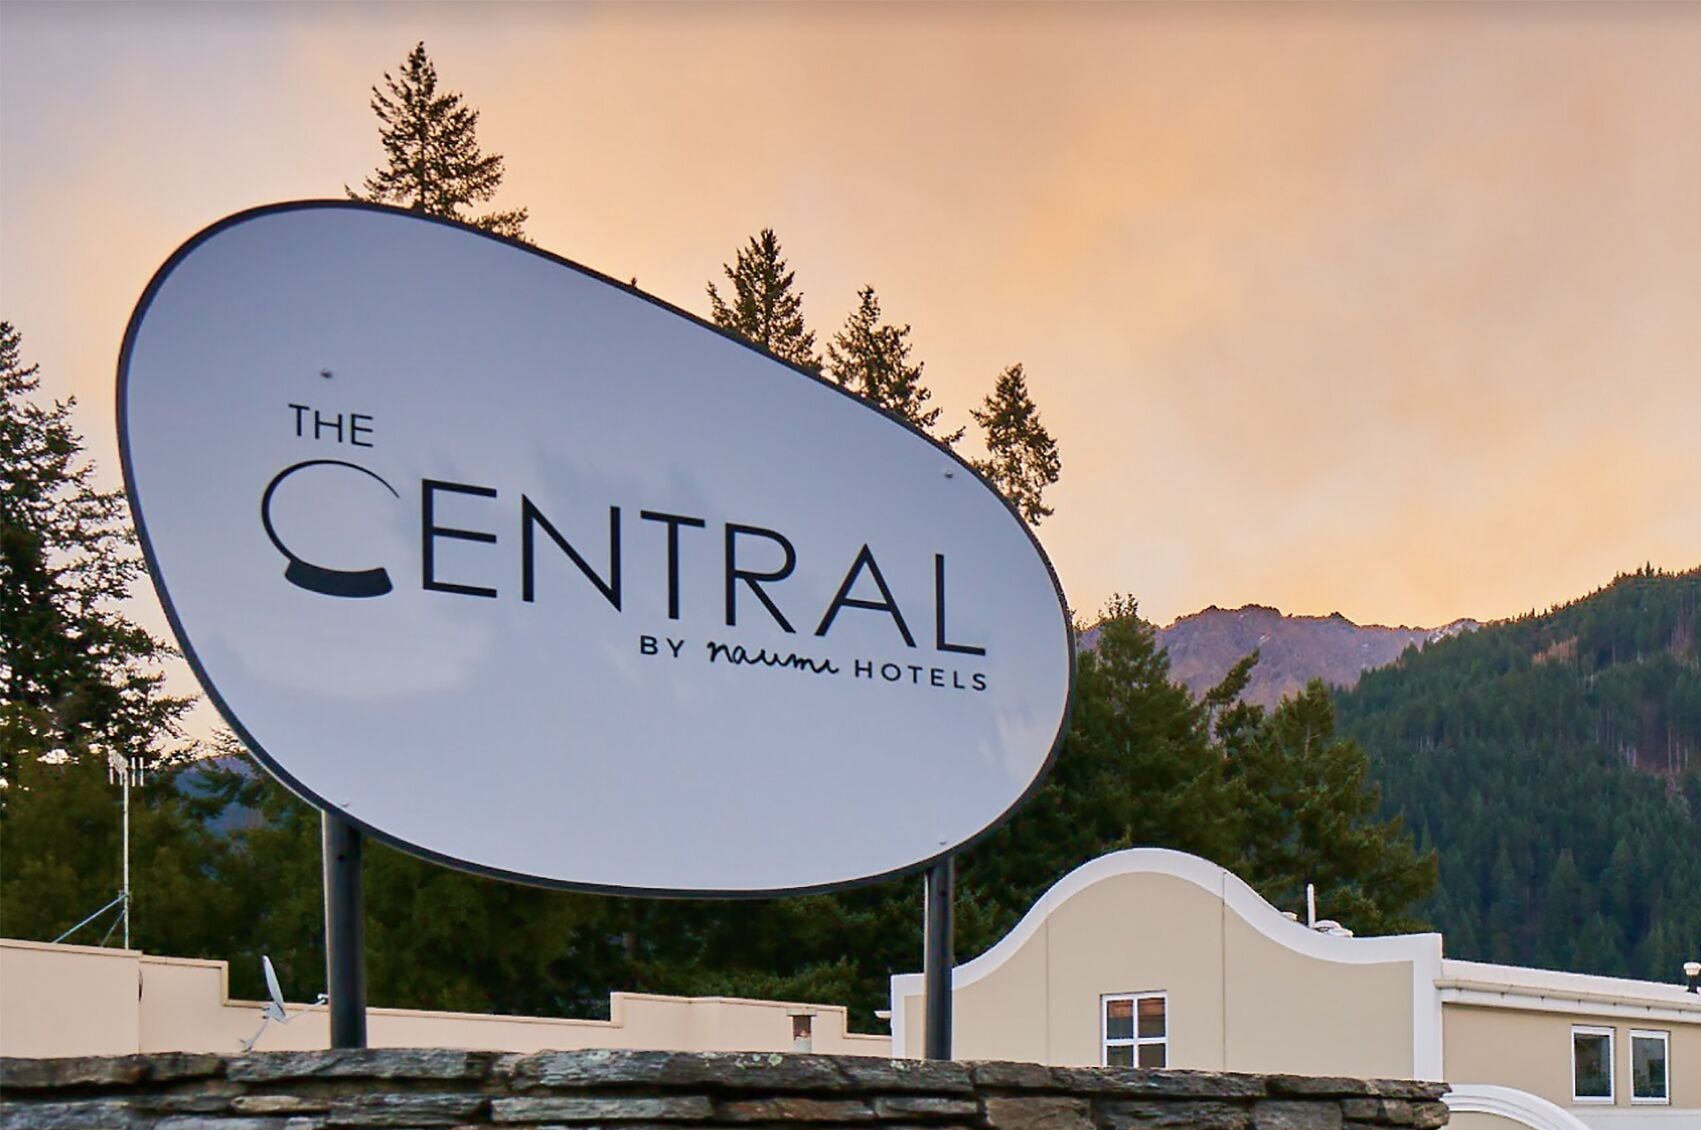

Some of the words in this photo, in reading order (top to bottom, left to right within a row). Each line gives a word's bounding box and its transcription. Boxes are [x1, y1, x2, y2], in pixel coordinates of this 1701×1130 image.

[288, 403, 374, 448] THE
[260, 459, 987, 657] CENTRAL
[640, 634, 685, 659] BY
[707, 640, 840, 675] naumi
[854, 659, 987, 692] HOTELS
